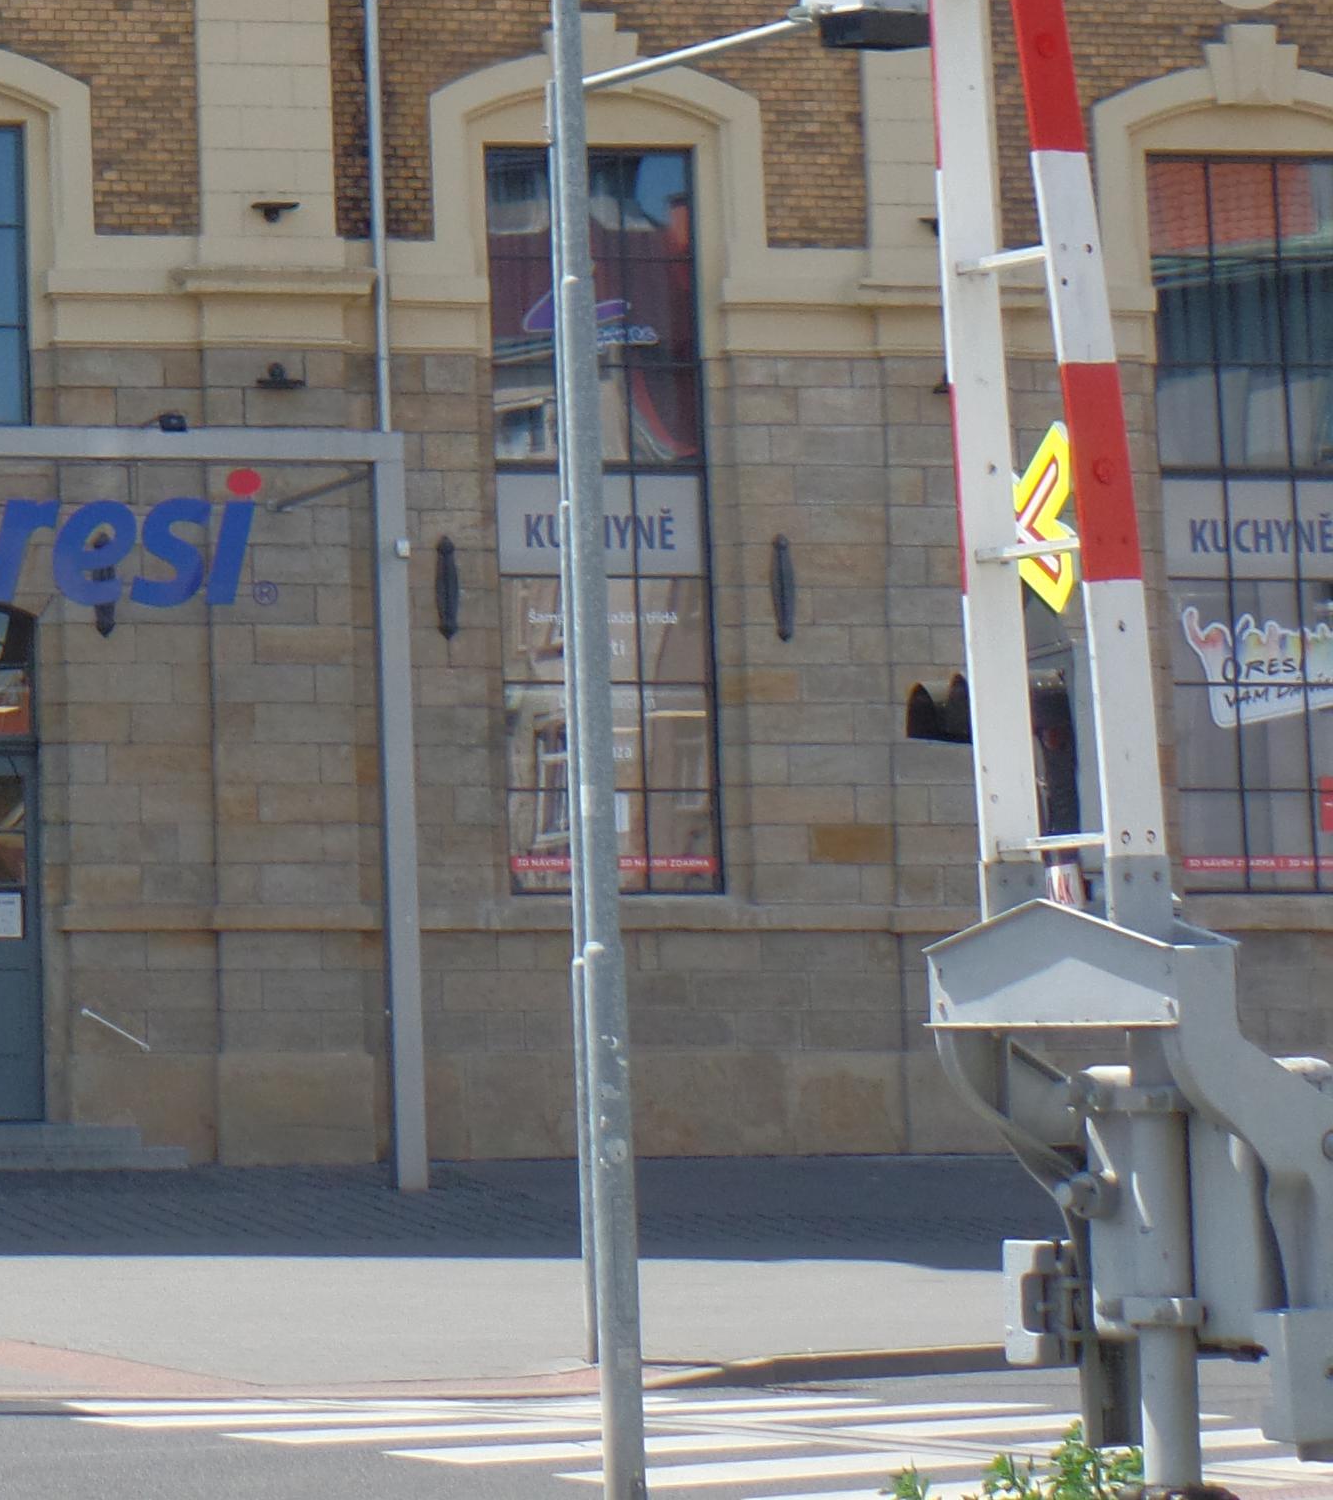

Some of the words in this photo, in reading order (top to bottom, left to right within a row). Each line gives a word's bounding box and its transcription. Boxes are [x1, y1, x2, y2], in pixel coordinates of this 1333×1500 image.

[524, 506, 677, 550] KUYNĚ
[1189, 511, 1333, 554] KUCHYNĚ
[1222, 656, 1304, 684] ORES
